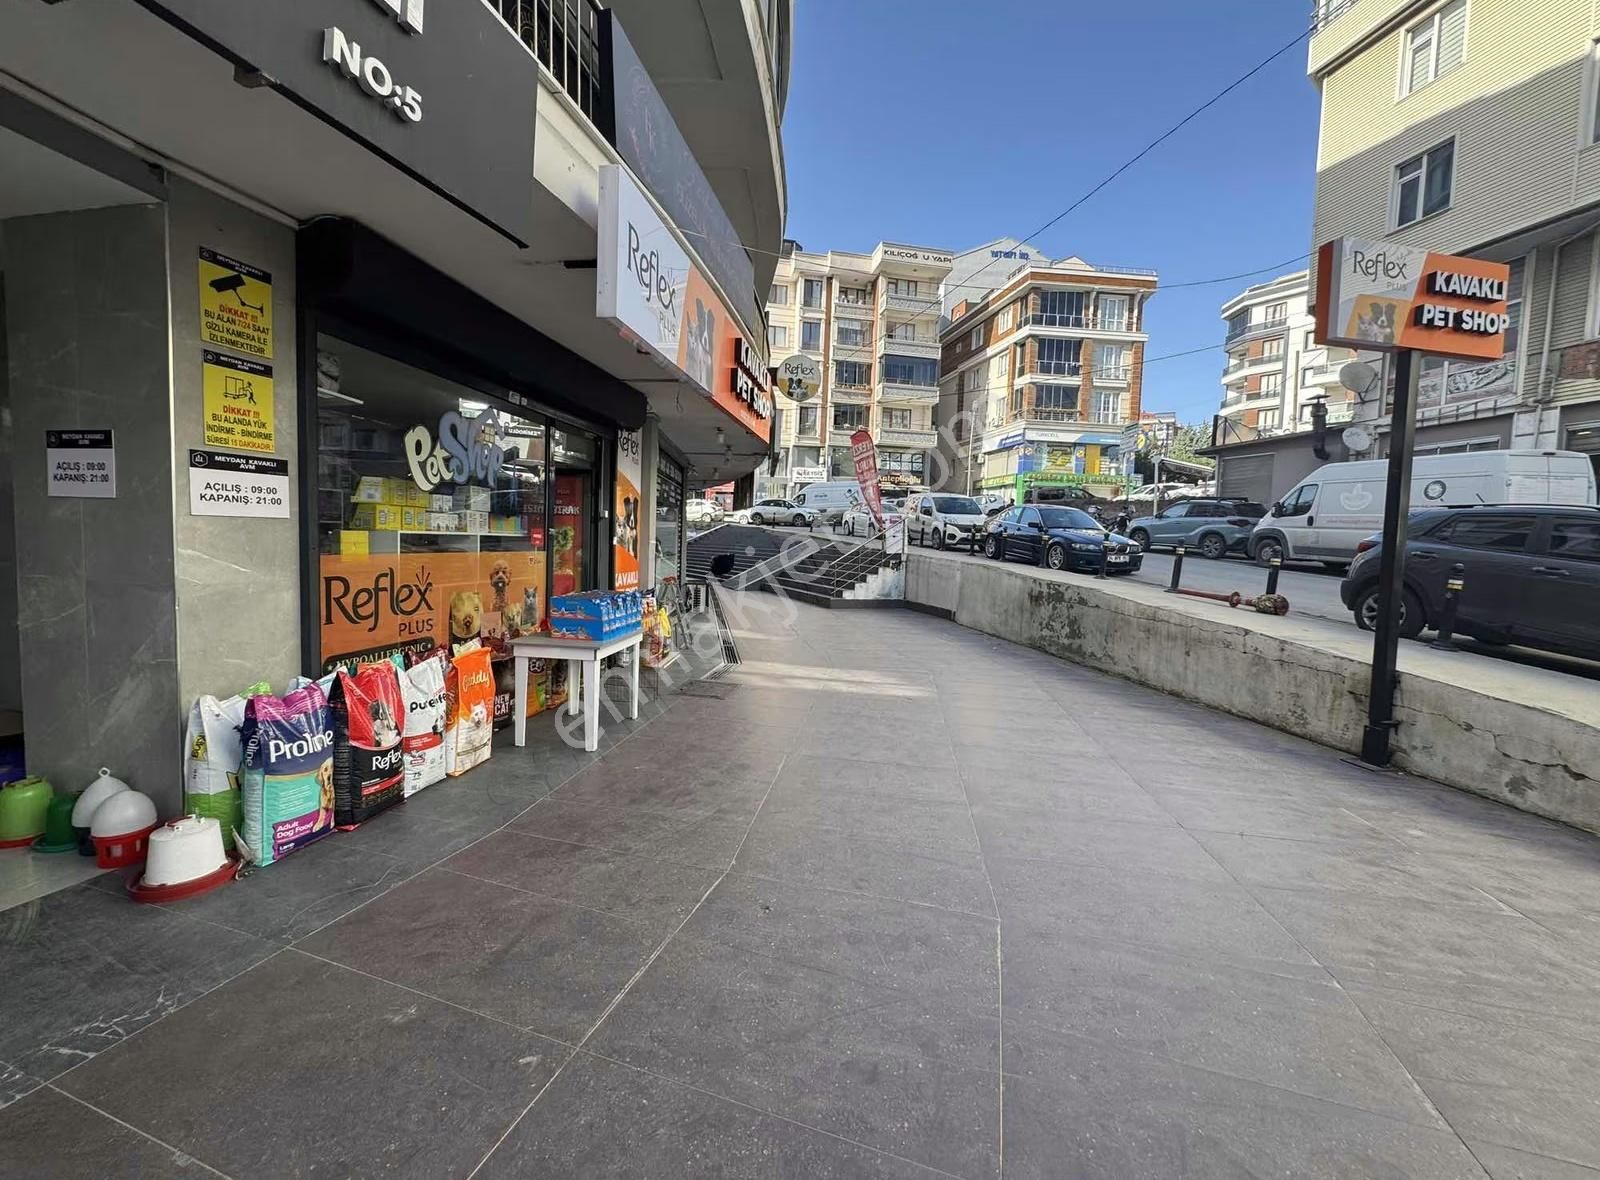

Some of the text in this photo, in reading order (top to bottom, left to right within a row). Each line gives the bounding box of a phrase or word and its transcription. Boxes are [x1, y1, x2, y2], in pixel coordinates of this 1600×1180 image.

[324, 27, 422, 122] NO:5
[626, 222, 676, 317] Reflex
[1352, 250, 1407, 283] Reflex
[1386, 281, 1408, 292] PLUS
[1435, 270, 1507, 301] KAVAKLI
[219, 304, 249, 320] DİKKAT
[1422, 304, 1510, 334] PET SHOP
[204, 309, 215, 319] BU
[216, 313, 236, 325] ALAN
[252, 323, 270, 335] SAAT
[205, 321, 224, 333] GİZLİ
[225, 326, 256, 342] KAMERA
[209, 331, 265, 354] İZLENMEKTEDİR
[784, 362, 814, 377] Reflex
[737, 367, 775, 418] PET SHOP
[223, 404, 251, 417] DİKKAT
[212, 413, 267, 430] BU ALANDA YÜK
[206, 421, 236, 435] İNDİRME
[241, 428, 273, 441] BİNDİRME
[206, 434, 229, 446] SÜRESİ
[405, 410, 504, 491] Pet Shop
[56, 461, 81, 472] AÇILIŞ
[86, 461, 106, 471] 09:00
[215, 455, 277, 468] MEYDAN KAVAKLI
[90, 473, 109, 483] 21:00
[204, 482, 242, 493] AÇILIŞ
[251, 485, 278, 495] 09:00
[200, 493, 282, 505] KAPANIŞ: 21:00
[323, 567, 434, 633] Reflex
[398, 619, 434, 637] PLUS
[495, 692, 510, 704] NEW
[495, 702, 510, 715] CAT
[270, 730, 334, 763] Proline
[276, 820, 299, 834] Adult
[276, 828, 294, 840] Dog
[296, 821, 315, 834] Food
